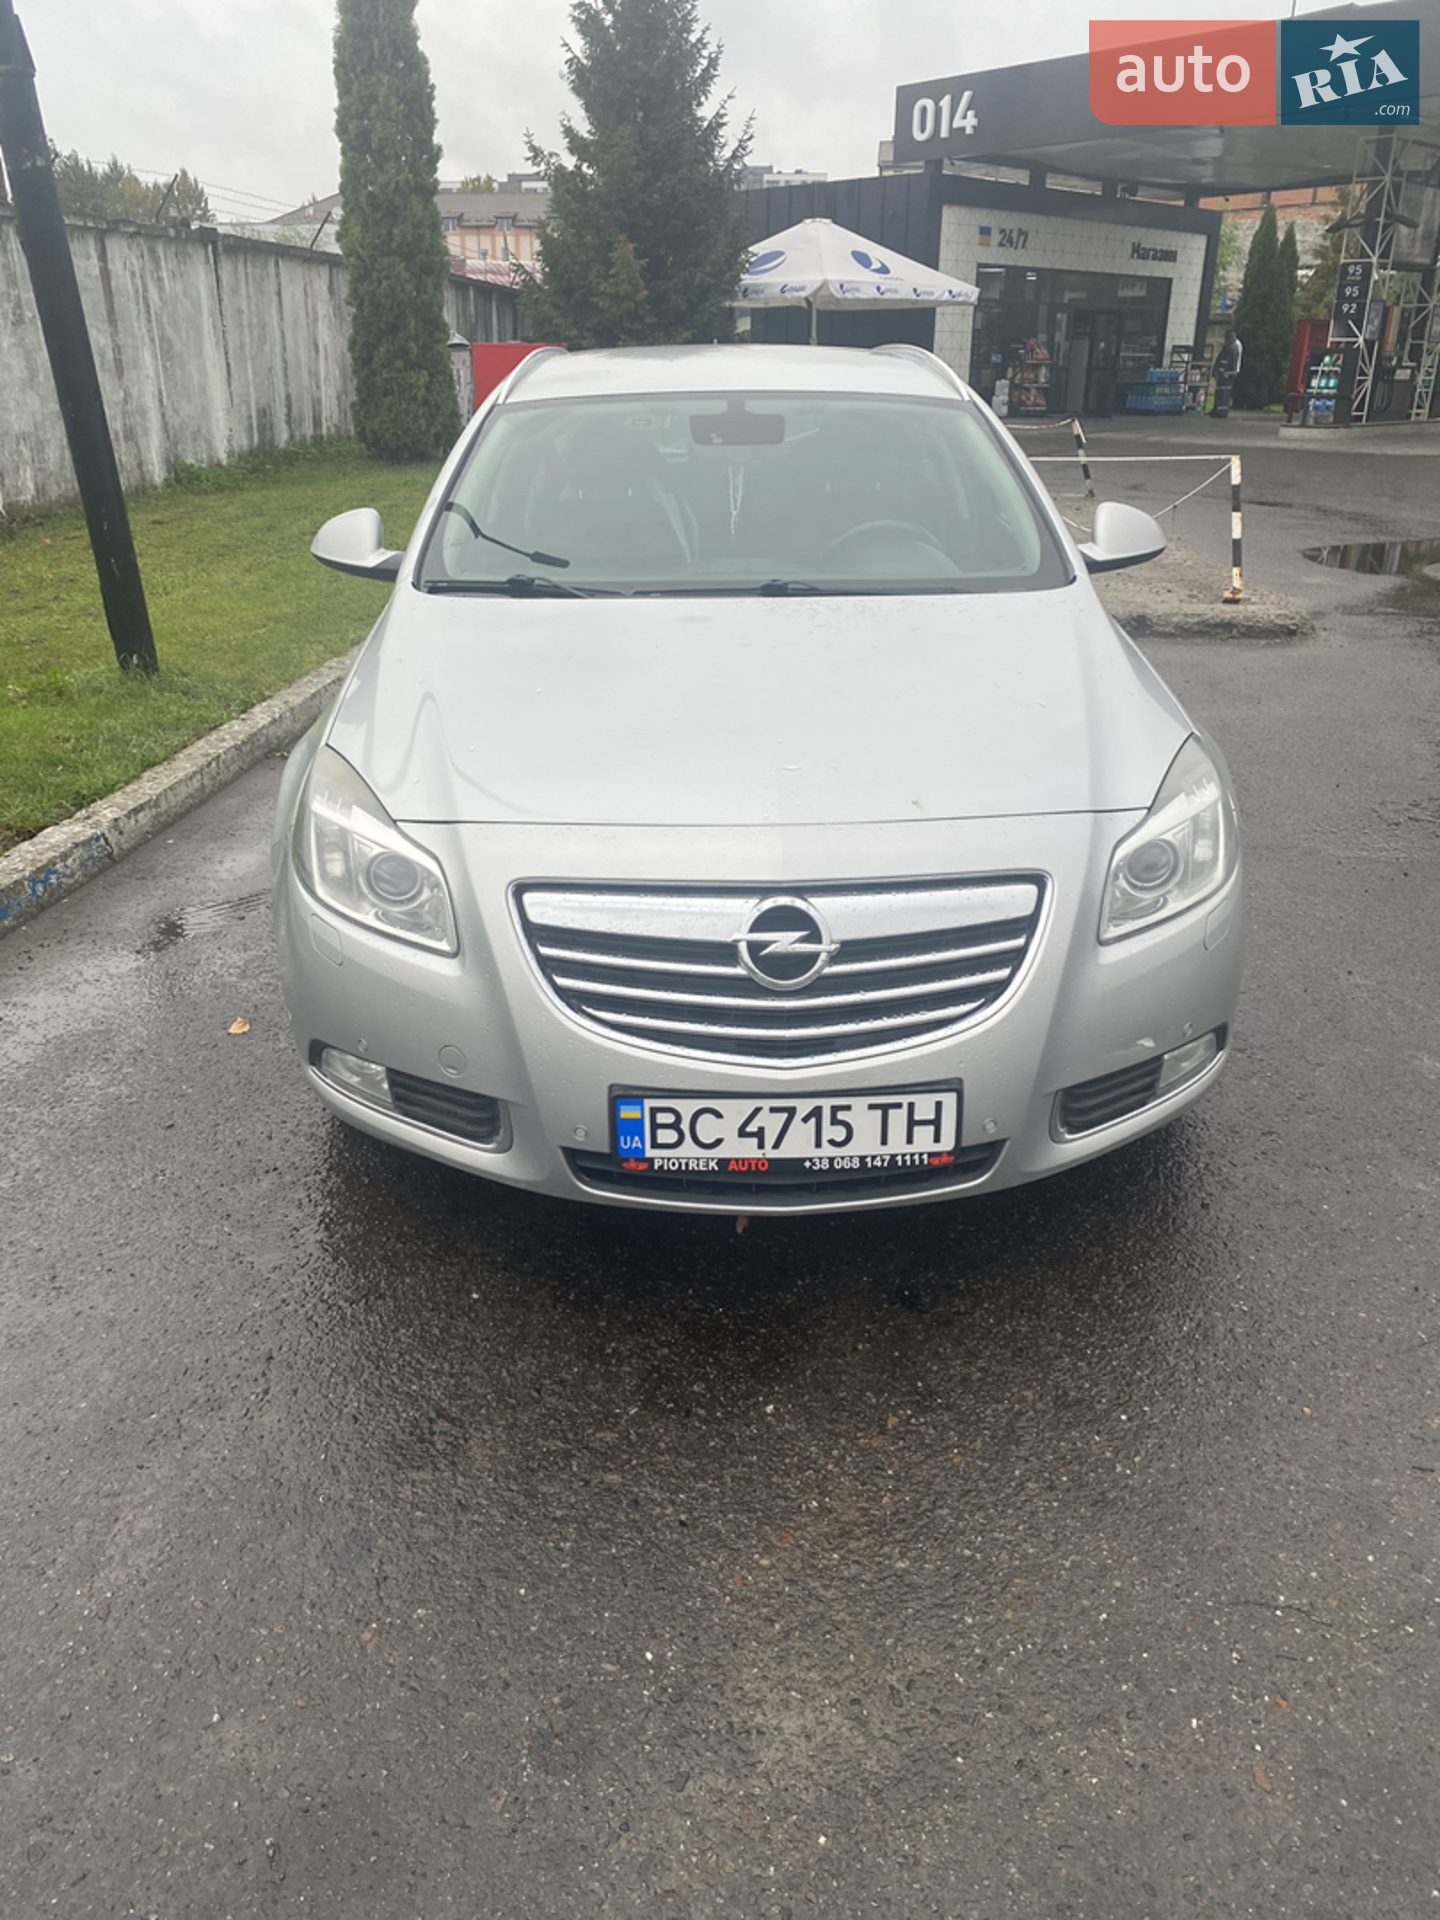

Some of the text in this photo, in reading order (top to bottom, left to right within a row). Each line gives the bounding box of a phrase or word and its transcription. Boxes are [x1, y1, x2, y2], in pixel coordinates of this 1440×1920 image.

[912, 90, 978, 141] 014
[998, 227, 1029, 251] 24/7
[1131, 242, 1177, 263] Магазин
[1347, 264, 1362, 276] 95
[1344, 286, 1359, 297] 95
[1341, 303, 1357, 314] 92
[649, 1100, 943, 1150] BC 4715 TH
[619, 1135, 643, 1149] UA
[653, 1158, 769, 1171] PIOTREK AUTO
[803, 1153, 928, 1170] +38 068 147 1111
